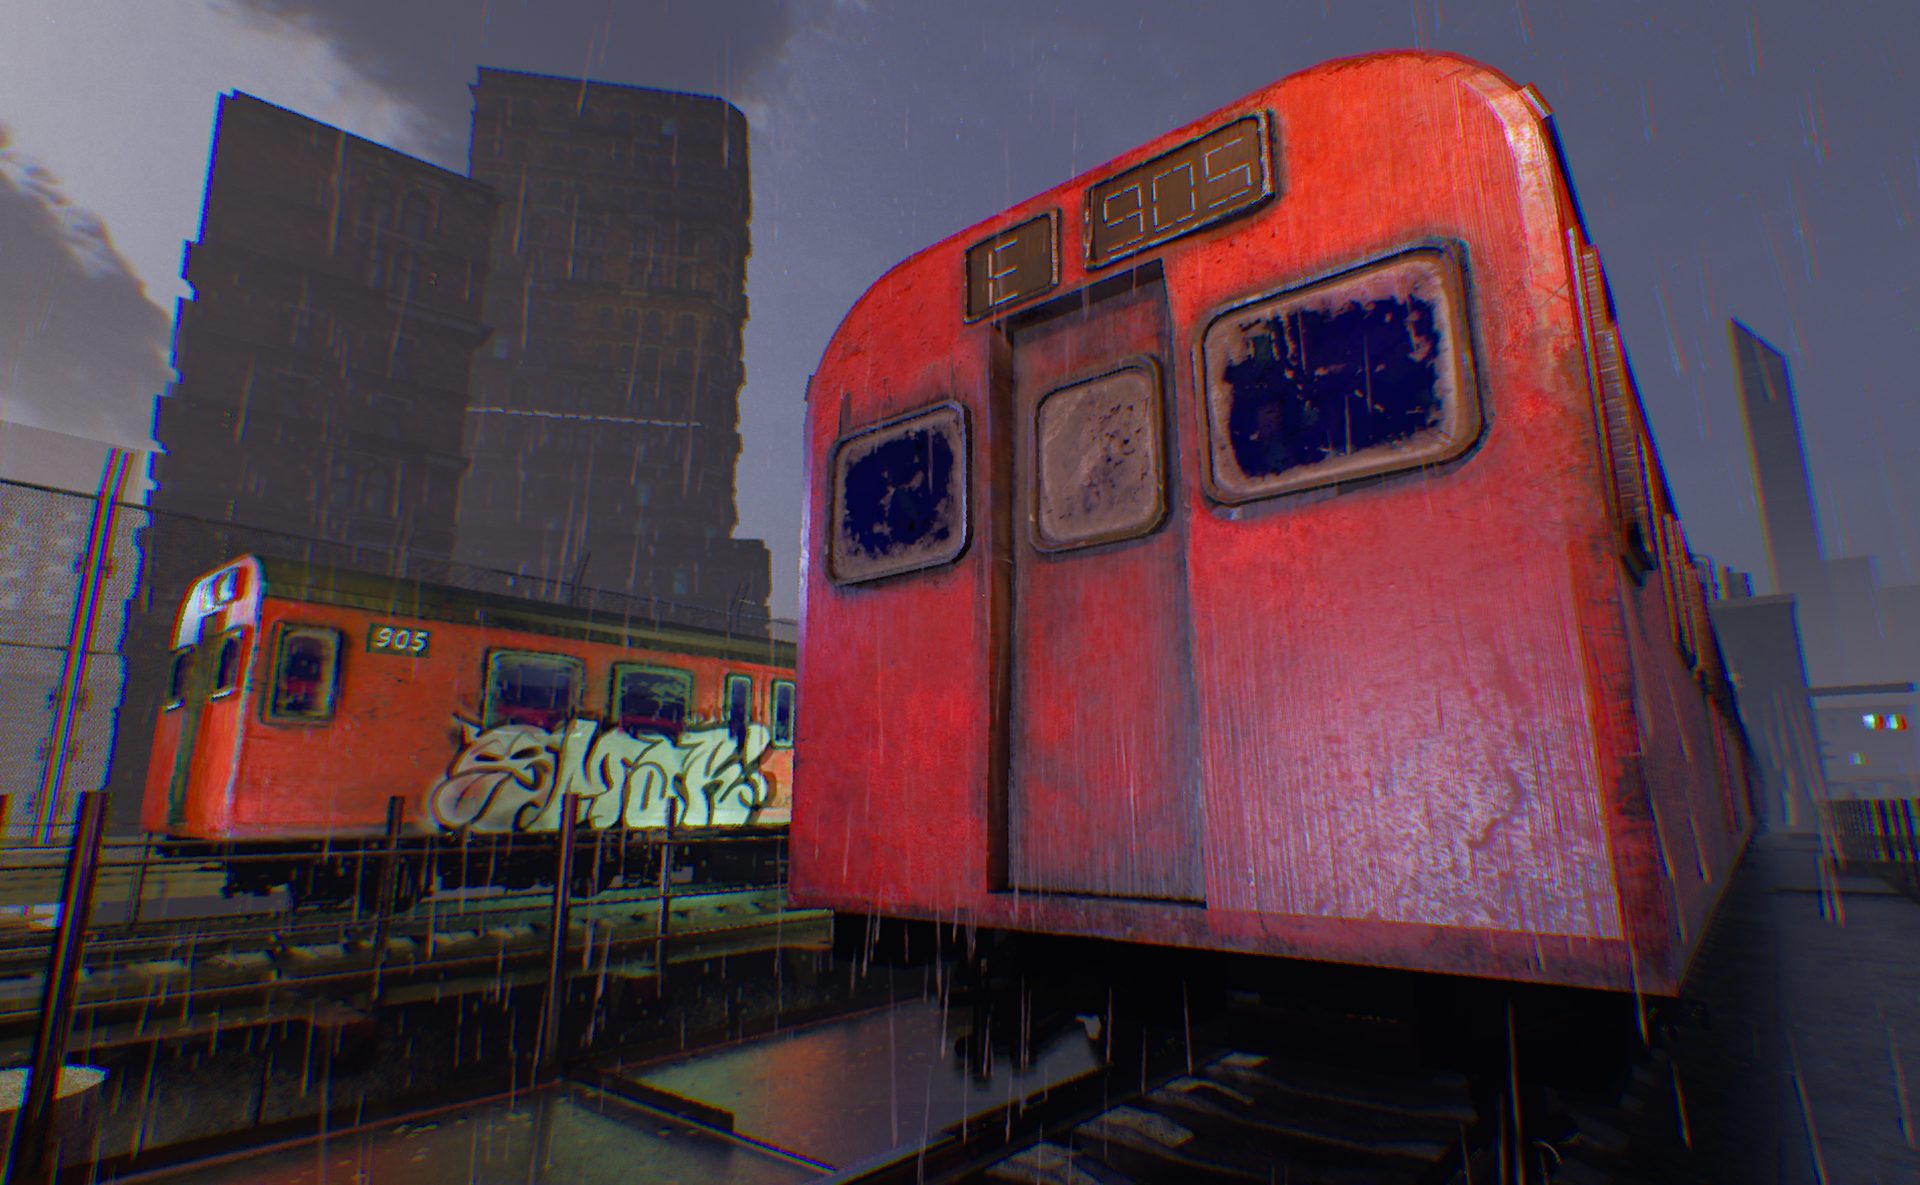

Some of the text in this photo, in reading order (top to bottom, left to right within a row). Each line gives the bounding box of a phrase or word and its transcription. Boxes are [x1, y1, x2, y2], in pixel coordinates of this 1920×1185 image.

[1103, 137, 1252, 253] 905
[987, 238, 1018, 307] E
[376, 627, 429, 651] 905
